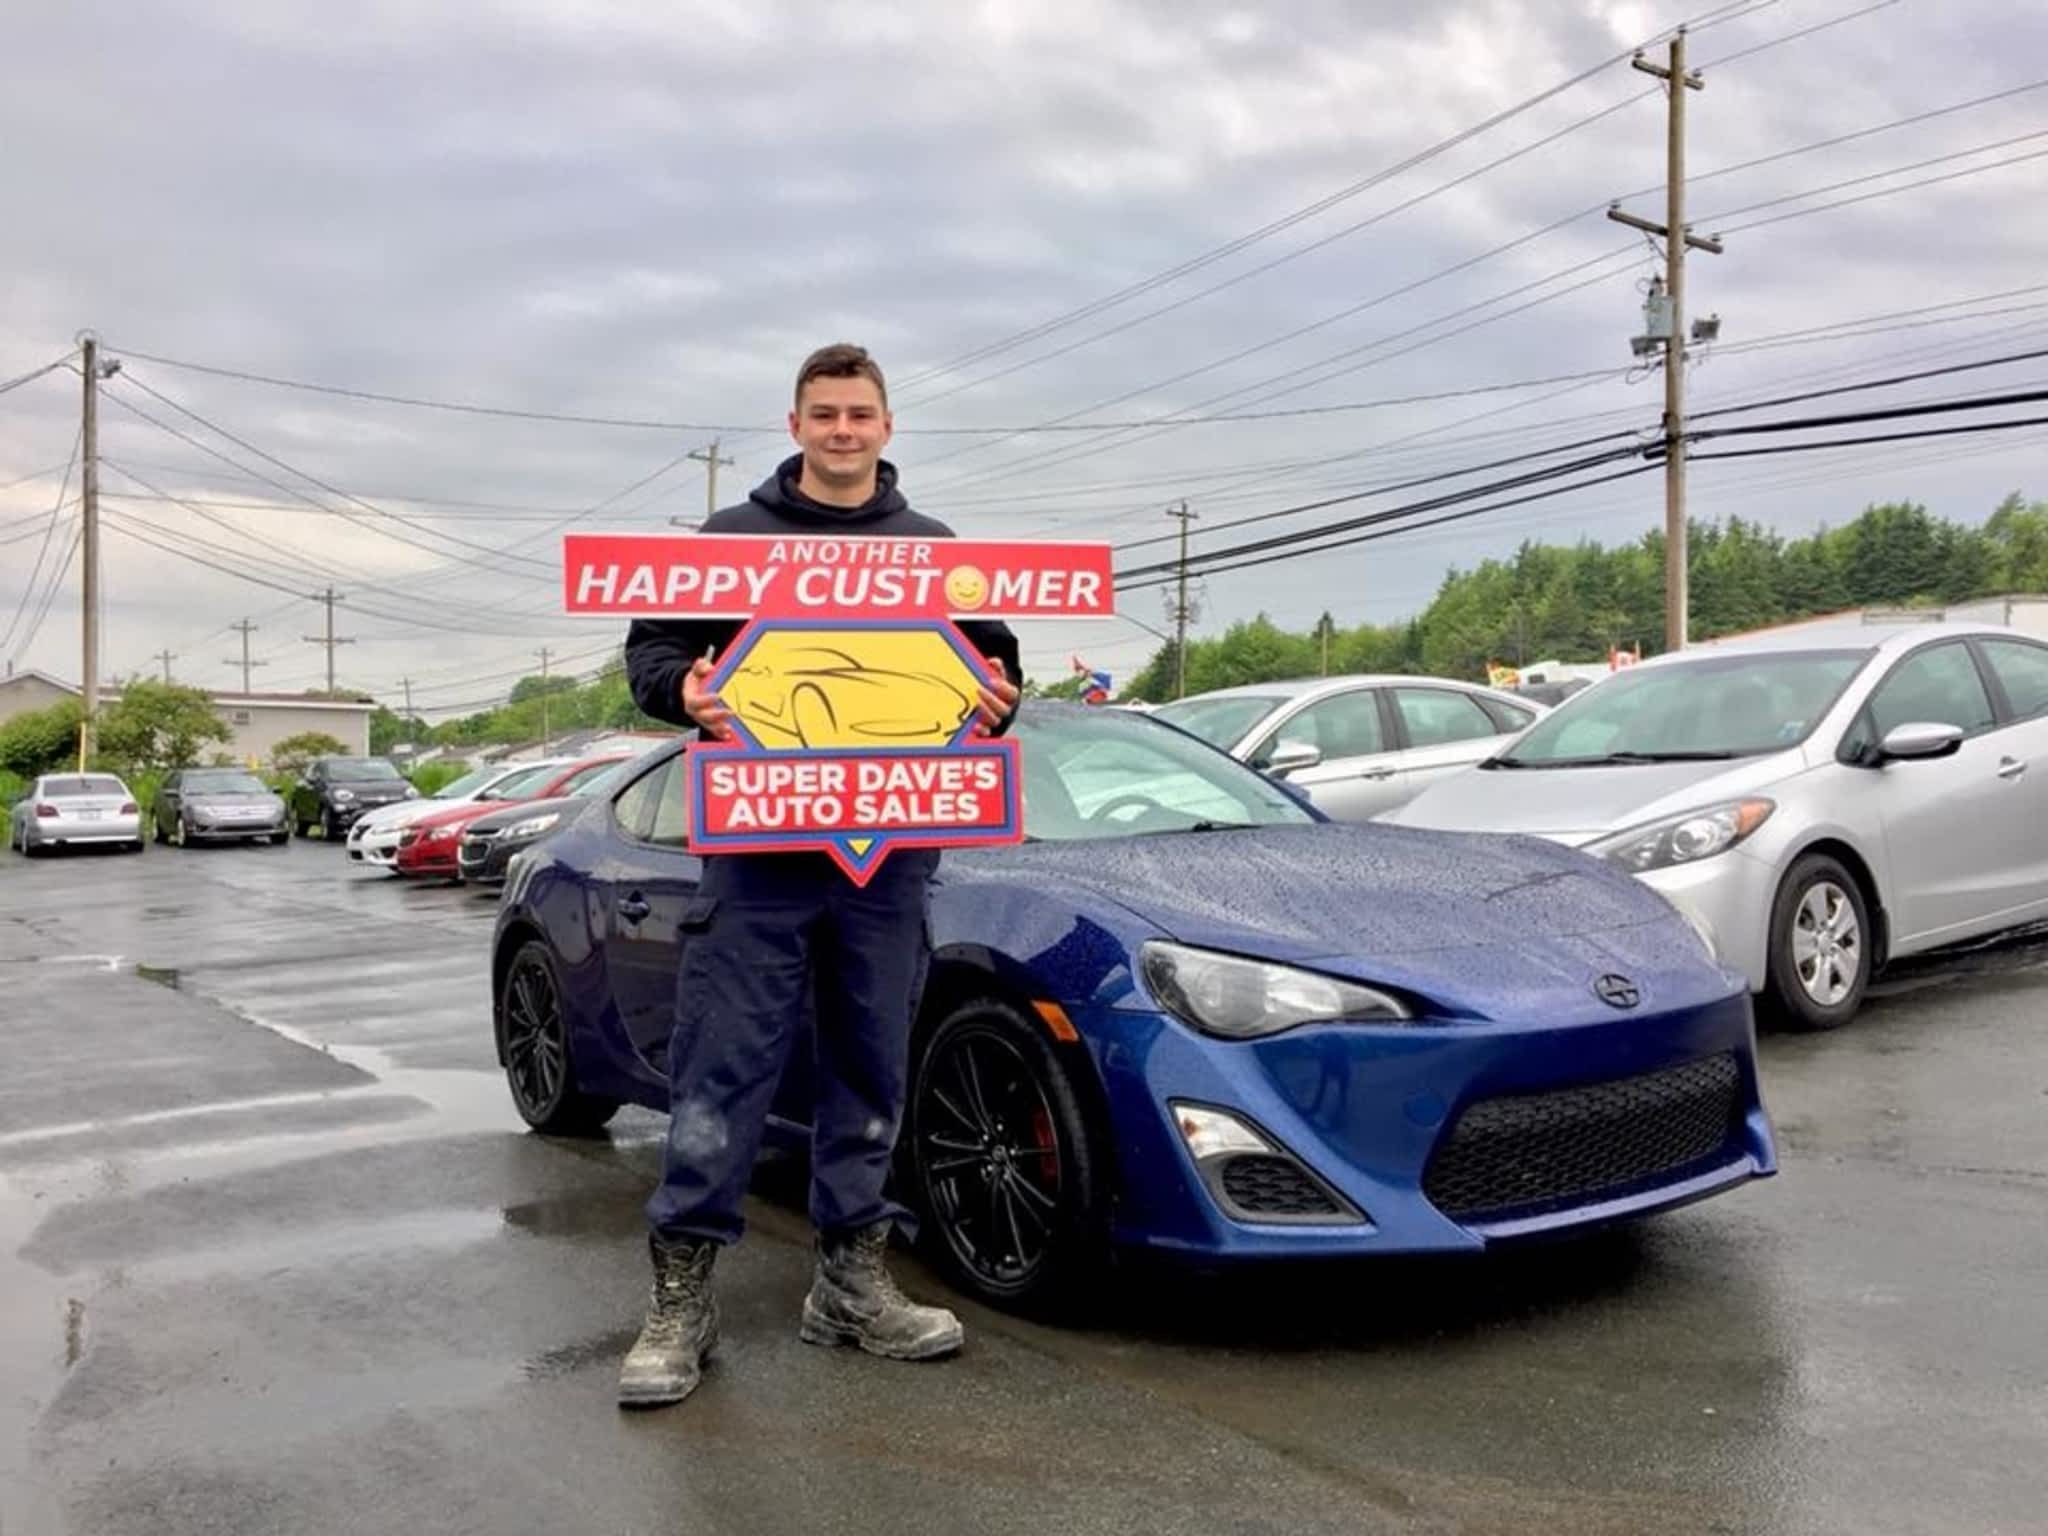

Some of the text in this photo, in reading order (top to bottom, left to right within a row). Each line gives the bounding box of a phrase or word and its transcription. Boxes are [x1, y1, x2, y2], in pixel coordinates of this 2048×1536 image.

[767, 540, 932, 565] ANOTHER
[576, 564, 778, 605] HAPPY
[711, 760, 998, 796] SUPER DAVE'S
[727, 792, 980, 828] AUTO SALES
